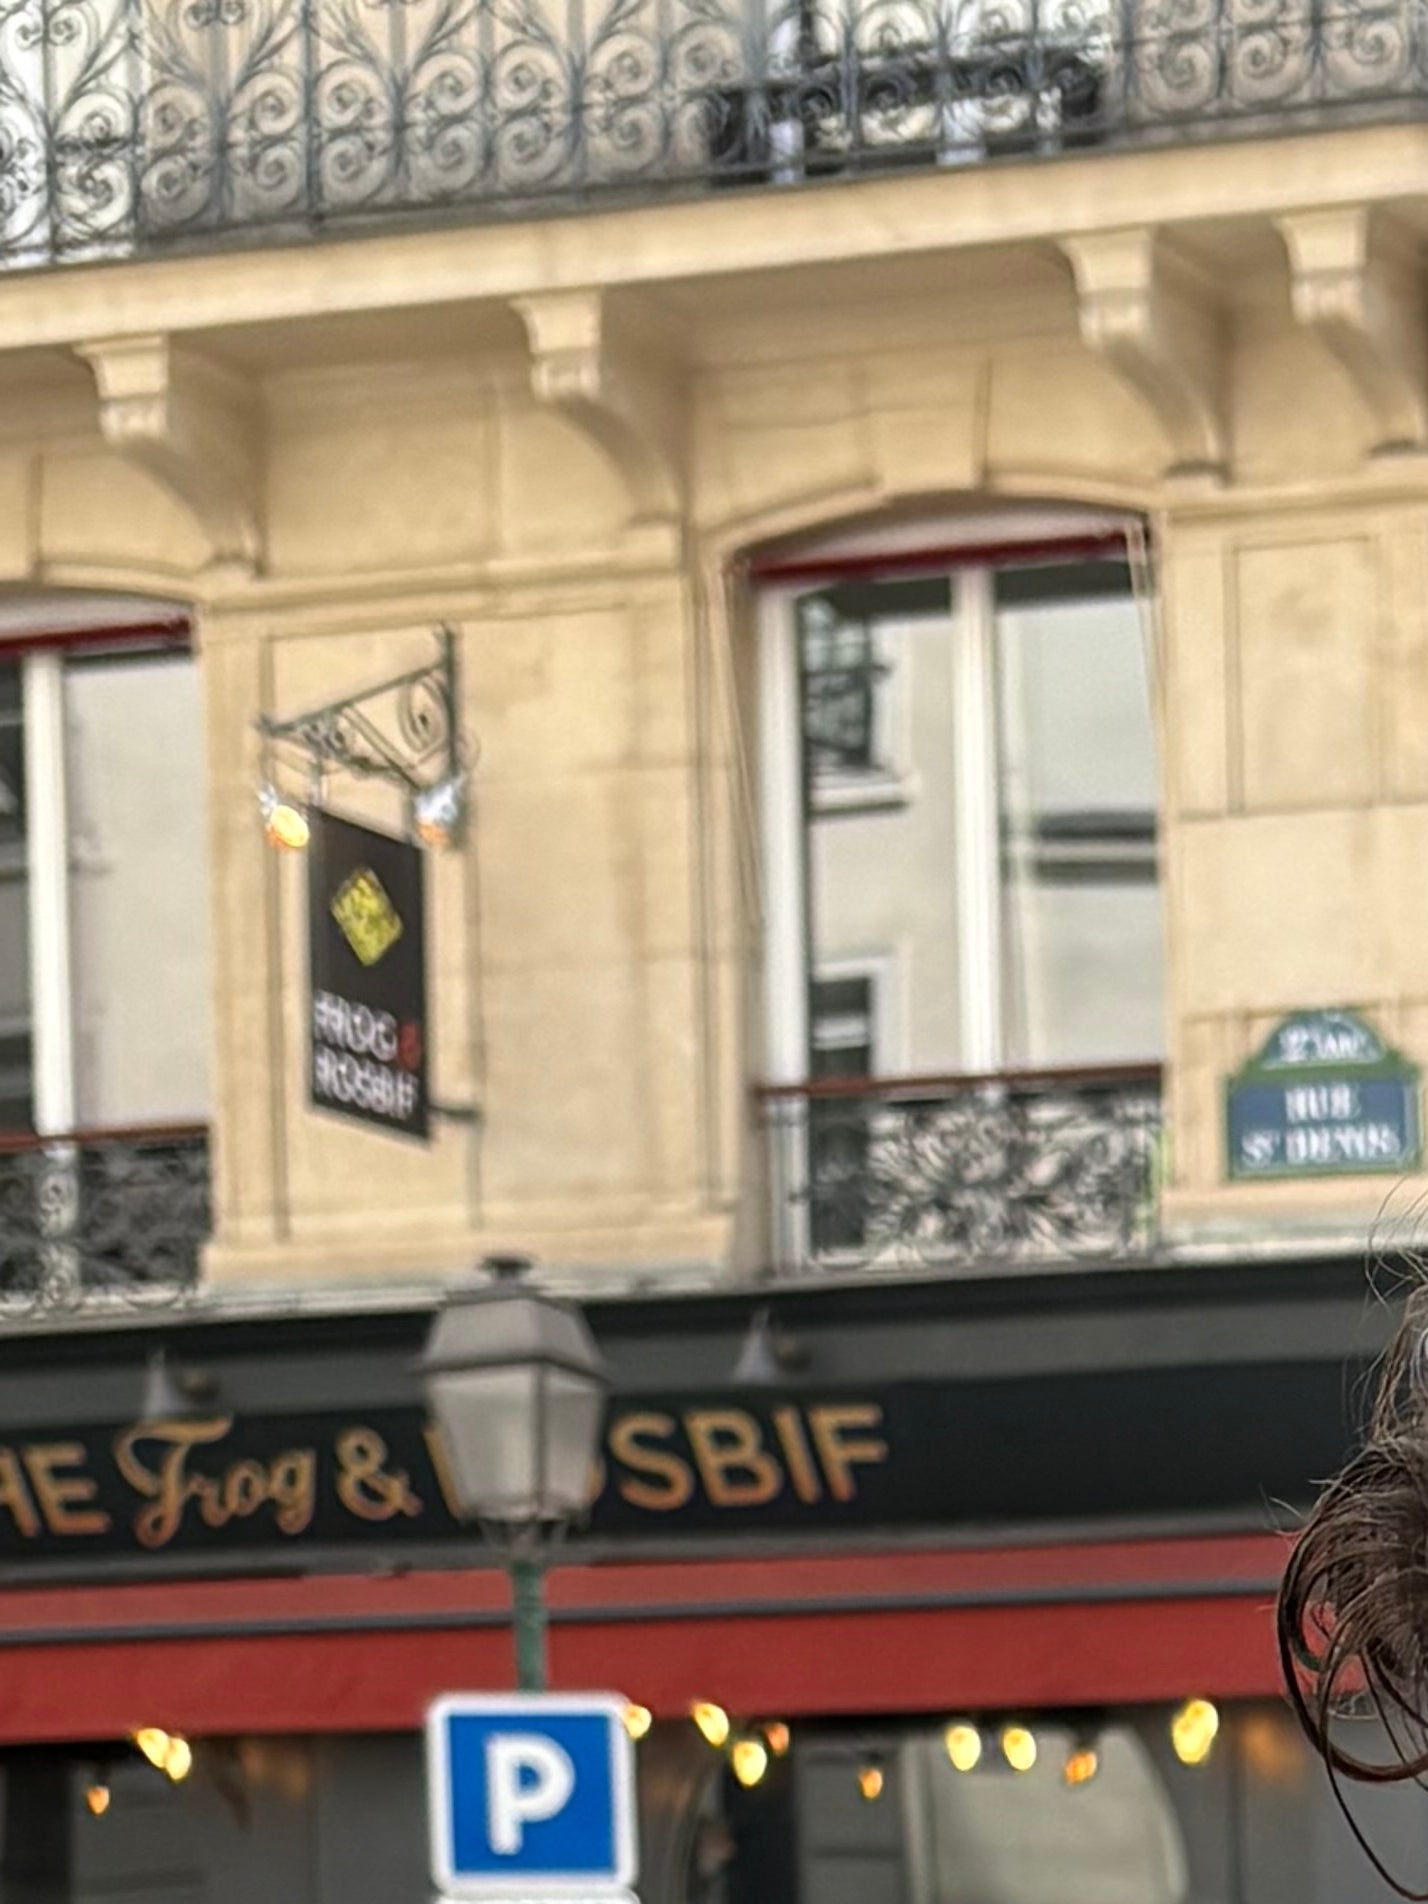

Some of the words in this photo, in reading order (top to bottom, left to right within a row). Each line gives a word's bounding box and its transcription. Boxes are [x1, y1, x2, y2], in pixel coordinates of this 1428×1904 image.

[112, 1412, 316, 1548] Frog
[335, 1425, 422, 1522] &
[422, 1402, 888, 1518] SBIF
[485, 1730, 576, 1855] P
